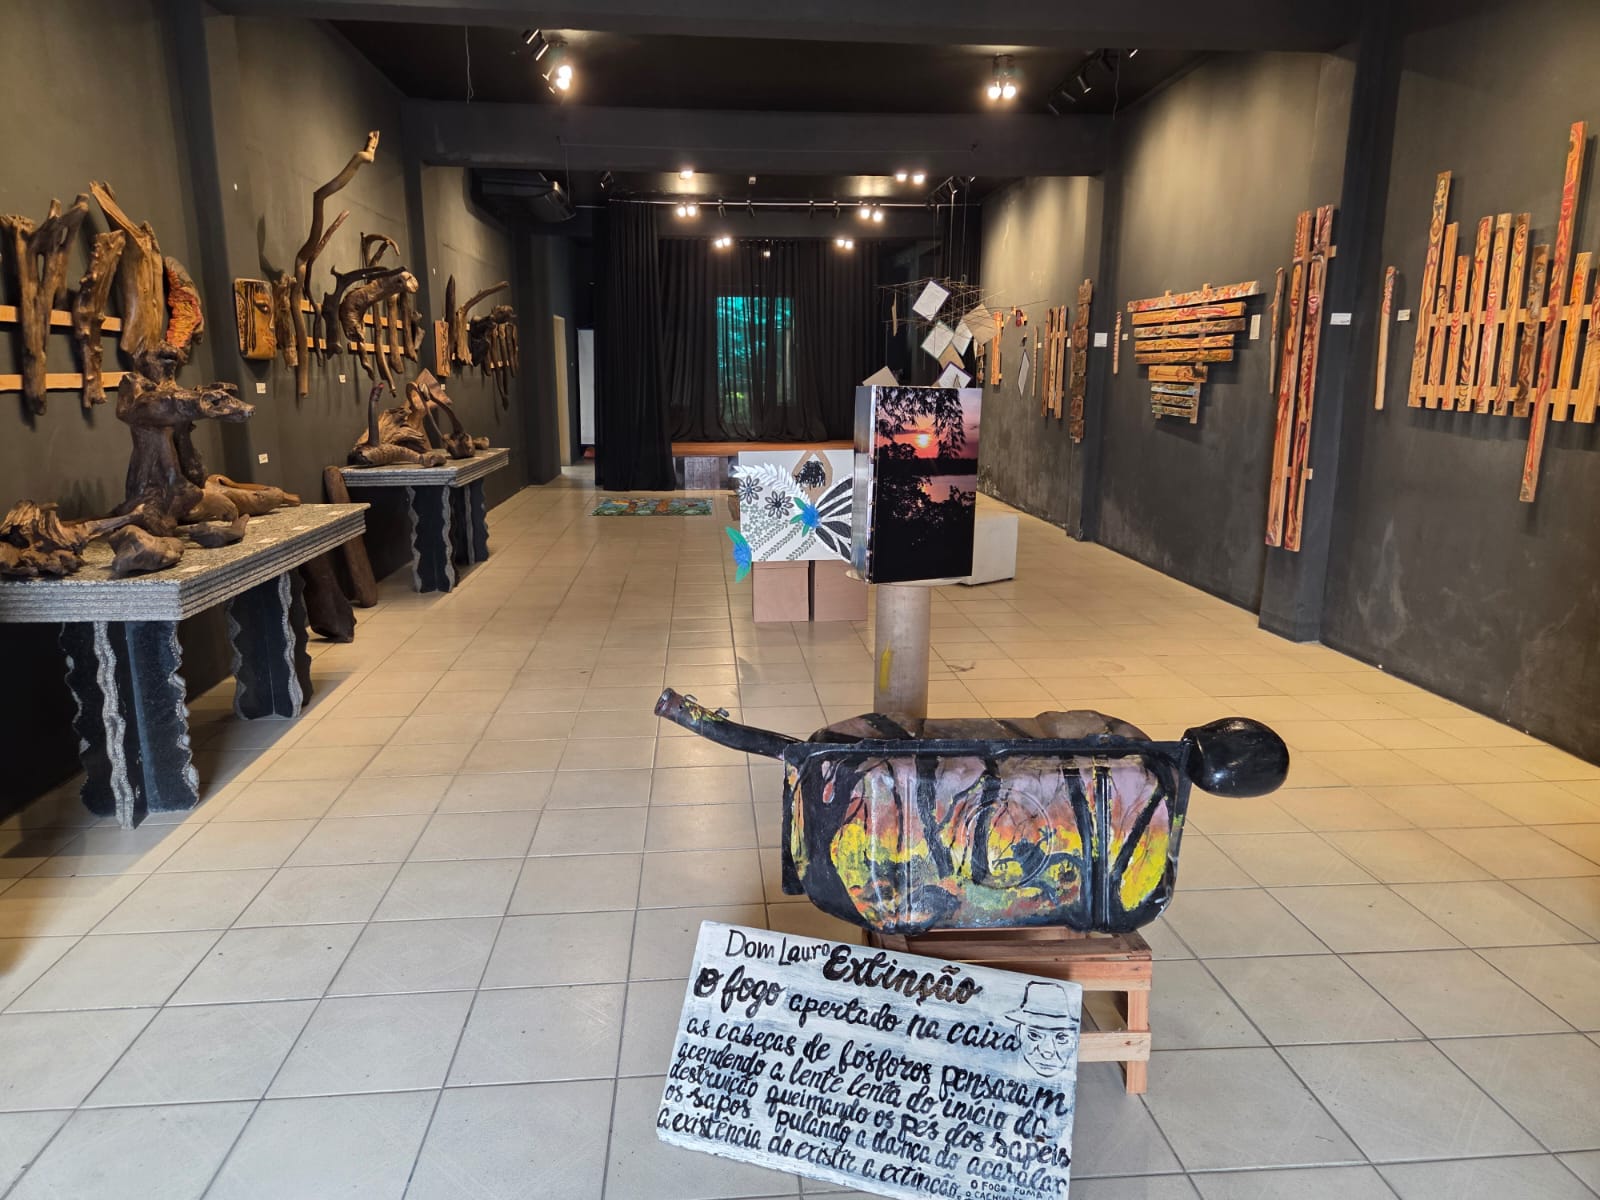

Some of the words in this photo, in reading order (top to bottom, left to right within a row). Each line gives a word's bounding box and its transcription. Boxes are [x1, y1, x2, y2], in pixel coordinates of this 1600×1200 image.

[725, 929, 774, 959] Dom
[778, 937, 831, 966] Lauro
[822, 944, 983, 1007] Extinção
[720, 965, 786, 1018] fogo
[788, 993, 902, 1032] apertado
[906, 1013, 941, 1040] na
[946, 1021, 1021, 1052] caixa
[669, 1059, 759, 1098] destruição
[765, 1084, 872, 1124] queimando
[873, 1109, 896, 1130] os
[897, 1113, 941, 1144] pés
[944, 1121, 986, 1153] dos
[677, 1042, 768, 1077] acendendo
[769, 1061, 786, 1083] a
[789, 1056, 845, 1094] lente
[846, 1072, 902, 1108] lenta
[905, 1085, 938, 1114] do
[942, 1092, 1008, 1129] início
[686, 1017, 711, 1038] as
[715, 1022, 797, 1057] cabeças
[802, 1033, 832, 1064] de
[838, 1040, 932, 1085] fósforos
[939, 1064, 1069, 1116] pensaram
[656, 1107, 670, 1129] a
[672, 1111, 763, 1150] existência
[767, 1128, 794, 1157] do
[794, 1141, 858, 1173] existir
[861, 1158, 877, 1180] a
[664, 1083, 683, 1101] os
[686, 1087, 752, 1119] sapos
[775, 1108, 853, 1147] pulando
[855, 1129, 868, 1149] a
[871, 1128, 932, 1164] dança
[935, 1145, 962, 1171] do
[981, 1181, 1008, 1193] FOGO
